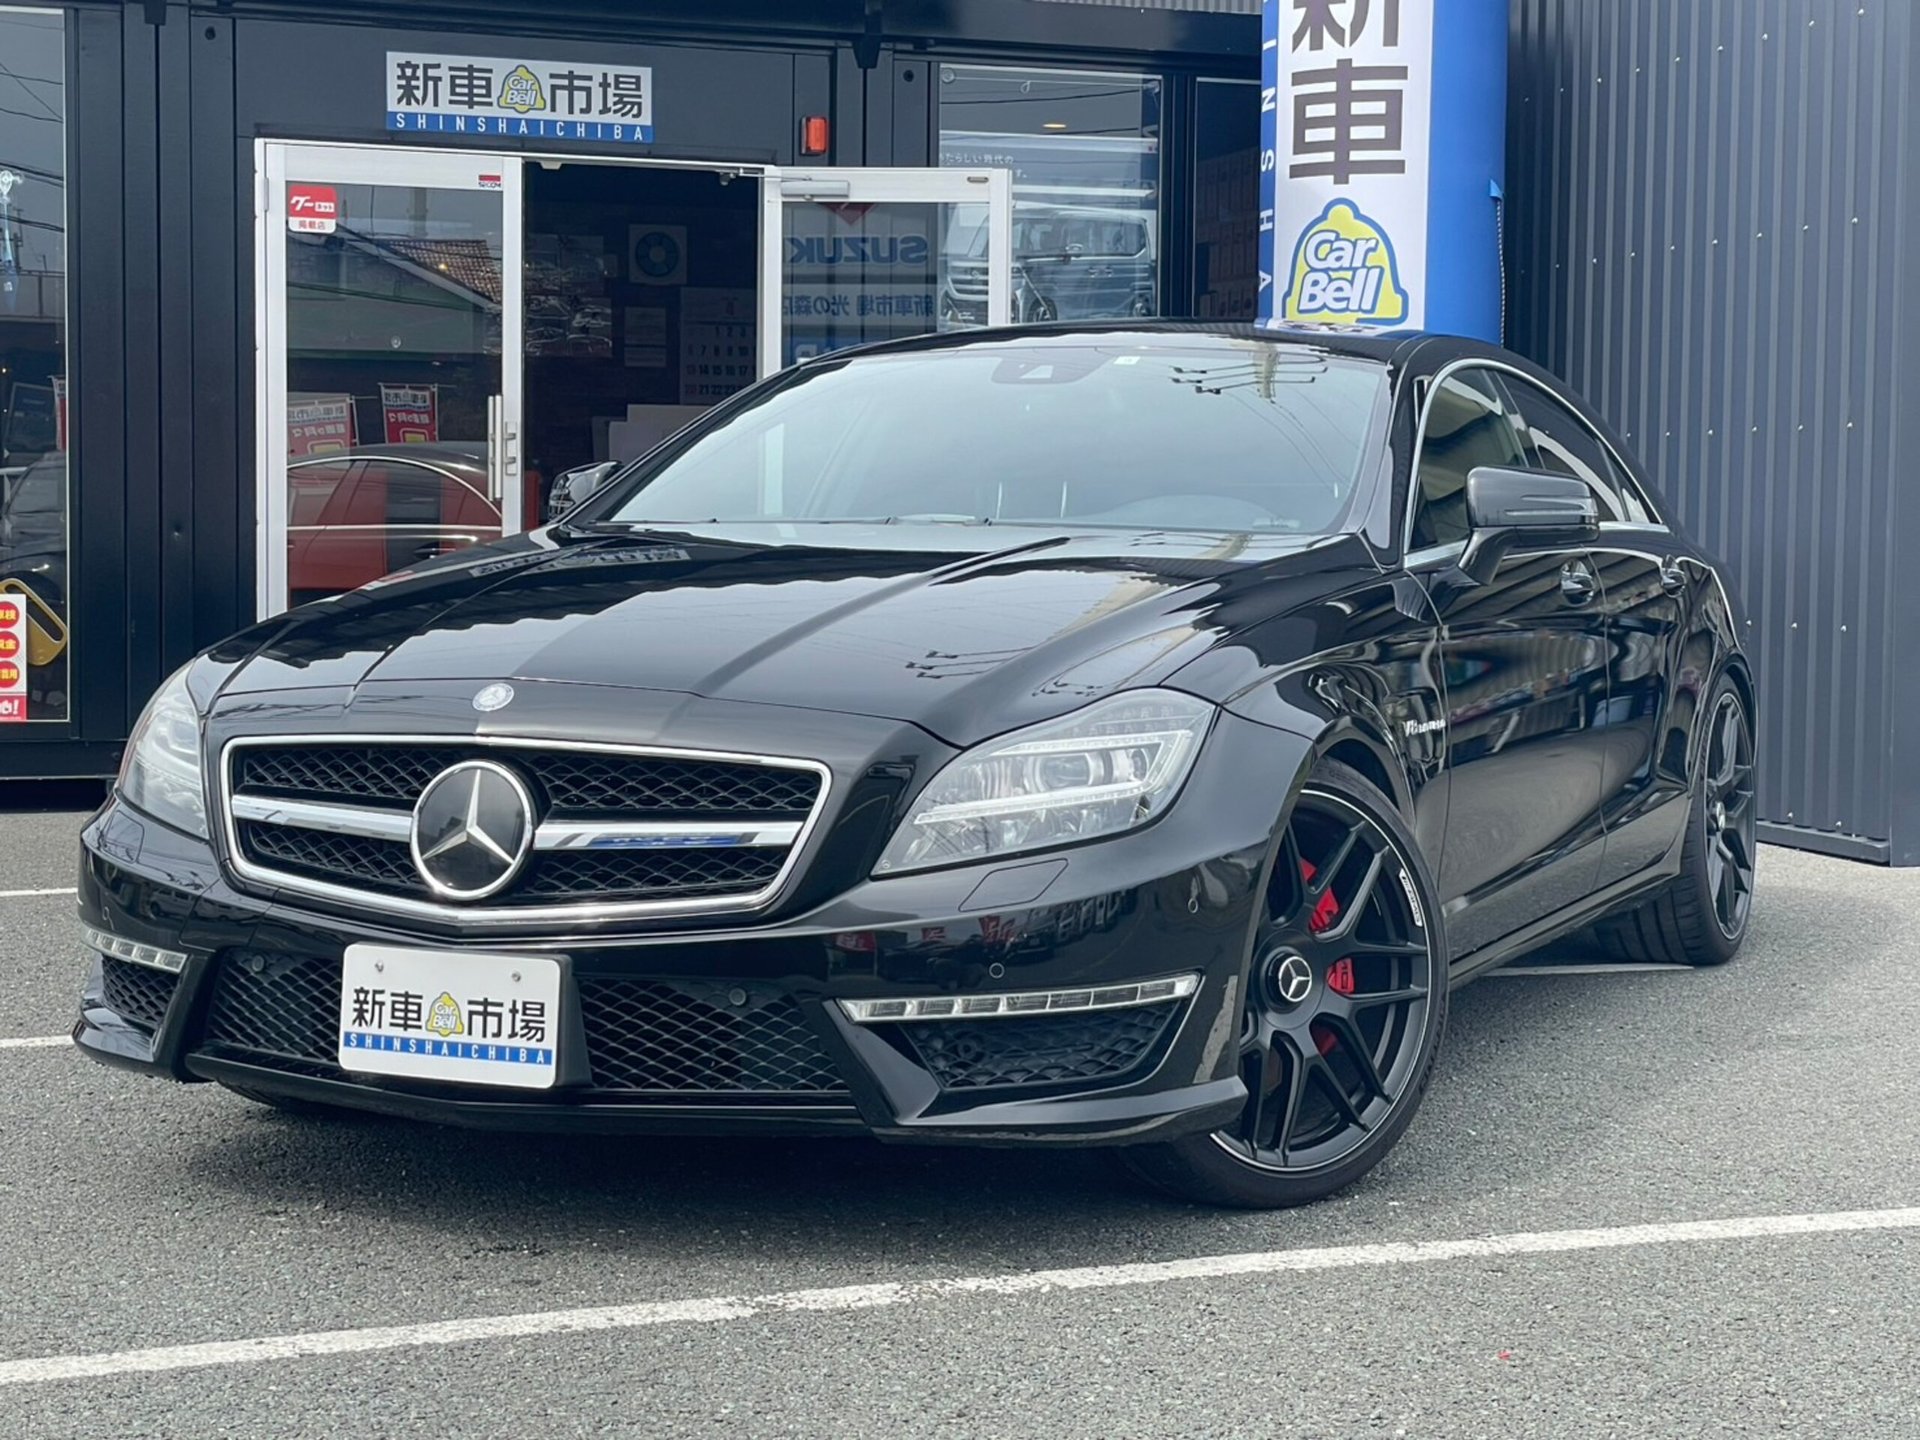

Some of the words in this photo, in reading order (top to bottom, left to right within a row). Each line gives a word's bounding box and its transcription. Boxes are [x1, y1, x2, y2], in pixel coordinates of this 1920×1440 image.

[396, 61, 494, 109] 新車
[548, 70, 643, 119] 市場
[506, 89, 537, 106] Bell
[507, 75, 537, 92] Car
[396, 113, 643, 141] SHINSHAICHIBA
[1258, 0, 1278, 295] INSHA
[1304, 229, 1377, 271] Car
[1298, 267, 1383, 314] Bell
[352, 986, 423, 1031] 新車
[466, 998, 546, 1043] 市場
[433, 1014, 457, 1030] Bell
[434, 1001, 457, 1016] Car
[349, 1033, 545, 1064] SHINSHAICHIBA
